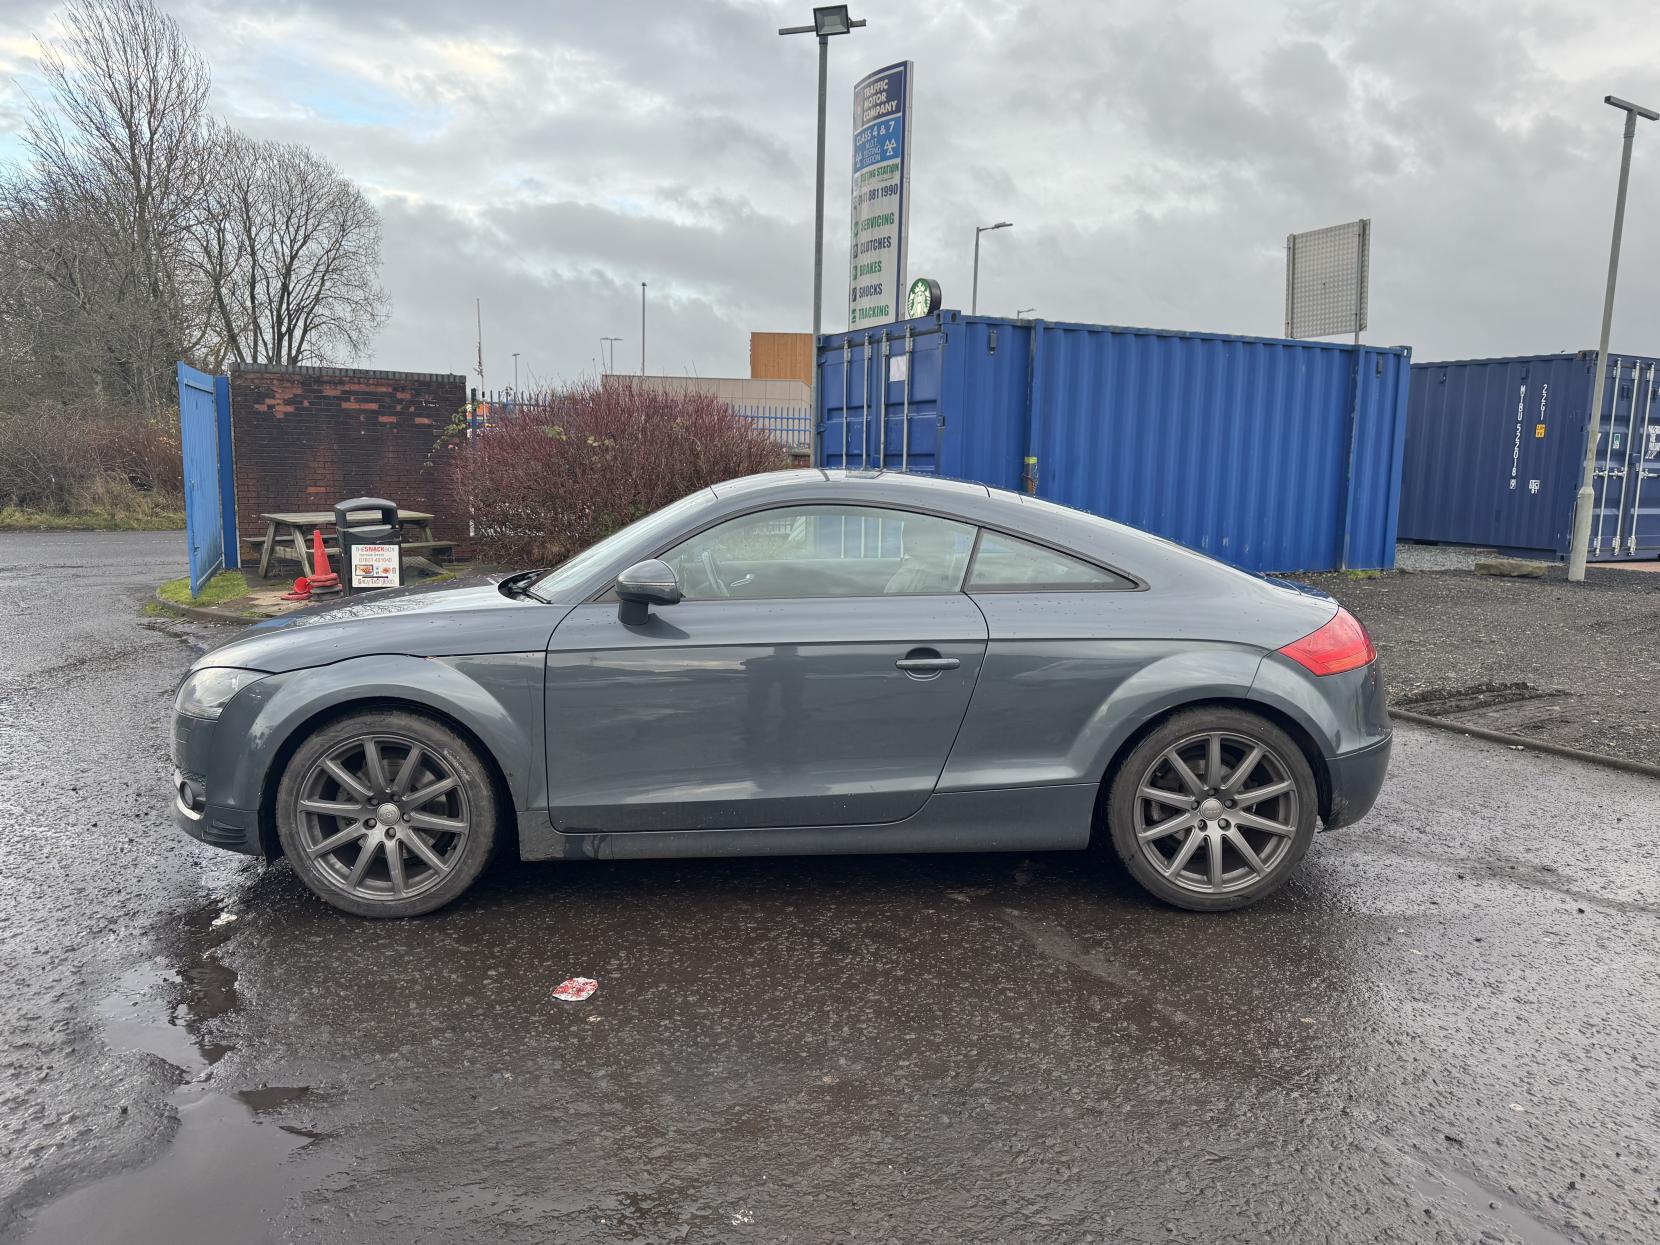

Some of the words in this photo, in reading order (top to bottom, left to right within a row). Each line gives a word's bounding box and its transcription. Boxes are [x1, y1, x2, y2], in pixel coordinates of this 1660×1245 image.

[864, 79, 889, 98] TRAFFIC
[863, 91, 887, 111] MOTOR
[863, 99, 898, 121] COMPANY
[856, 129, 871, 146] CLASS
[872, 124, 878, 137] 4
[879, 124, 886, 135] &
[889, 120, 896, 133] 7
[876, 161, 899, 177] STATION
[881, 183, 899, 198] 1990
[860, 212, 895, 232] SERVICING
[860, 236, 892, 254] CLUTCHES
[859, 261, 882, 277] BRAKES
[858, 283, 883, 298] SHOCKS
[858, 304, 889, 321] TRACKING
[1511, 423, 1522, 476] 522018
